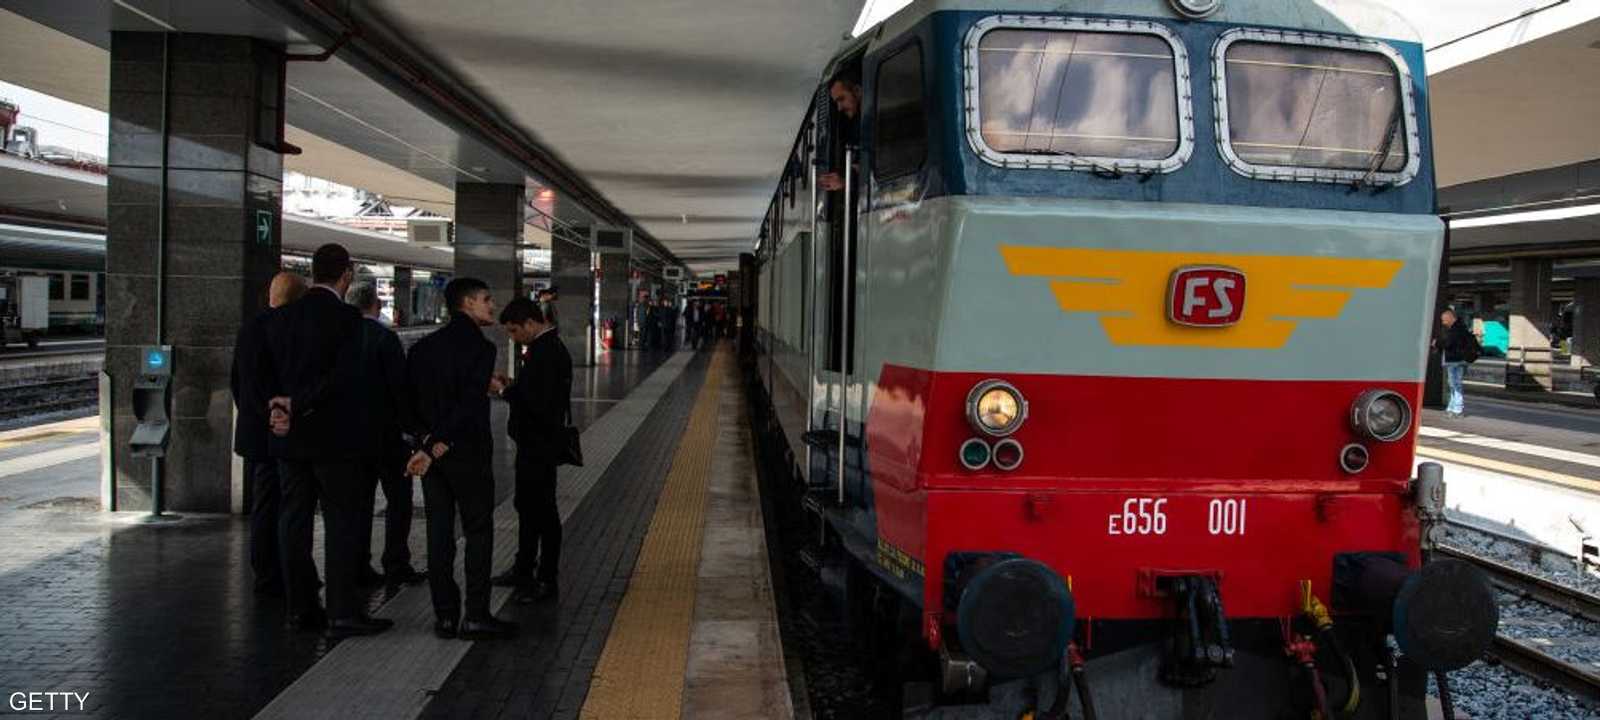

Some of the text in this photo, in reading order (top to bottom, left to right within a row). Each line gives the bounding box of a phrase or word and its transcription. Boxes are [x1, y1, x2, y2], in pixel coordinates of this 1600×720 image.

[1183, 278, 1236, 318] FS
[1108, 498, 1246, 535] E656 001
